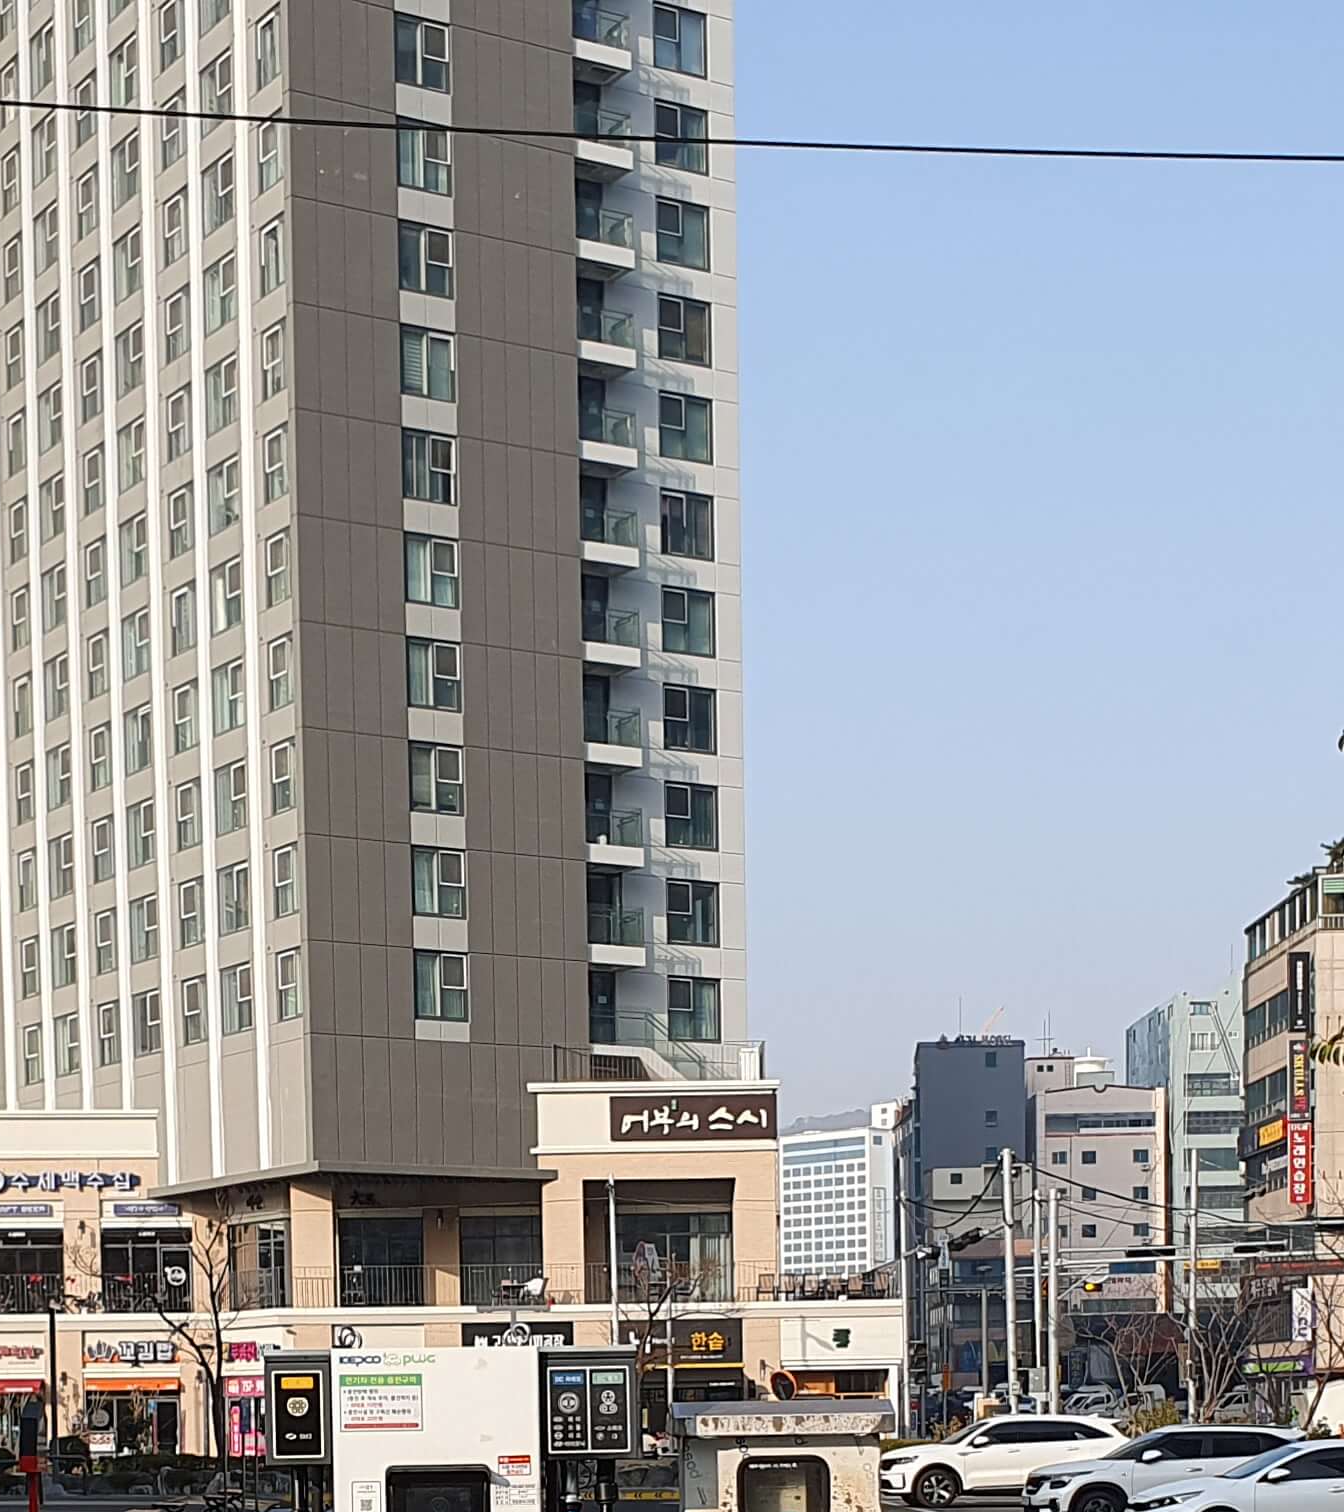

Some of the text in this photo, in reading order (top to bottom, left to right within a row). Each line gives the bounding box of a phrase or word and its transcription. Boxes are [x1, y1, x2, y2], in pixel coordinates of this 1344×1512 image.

[621, 1106, 768, 1135] 어부의 스시
[690, 1331, 724, 1352] 한솥
